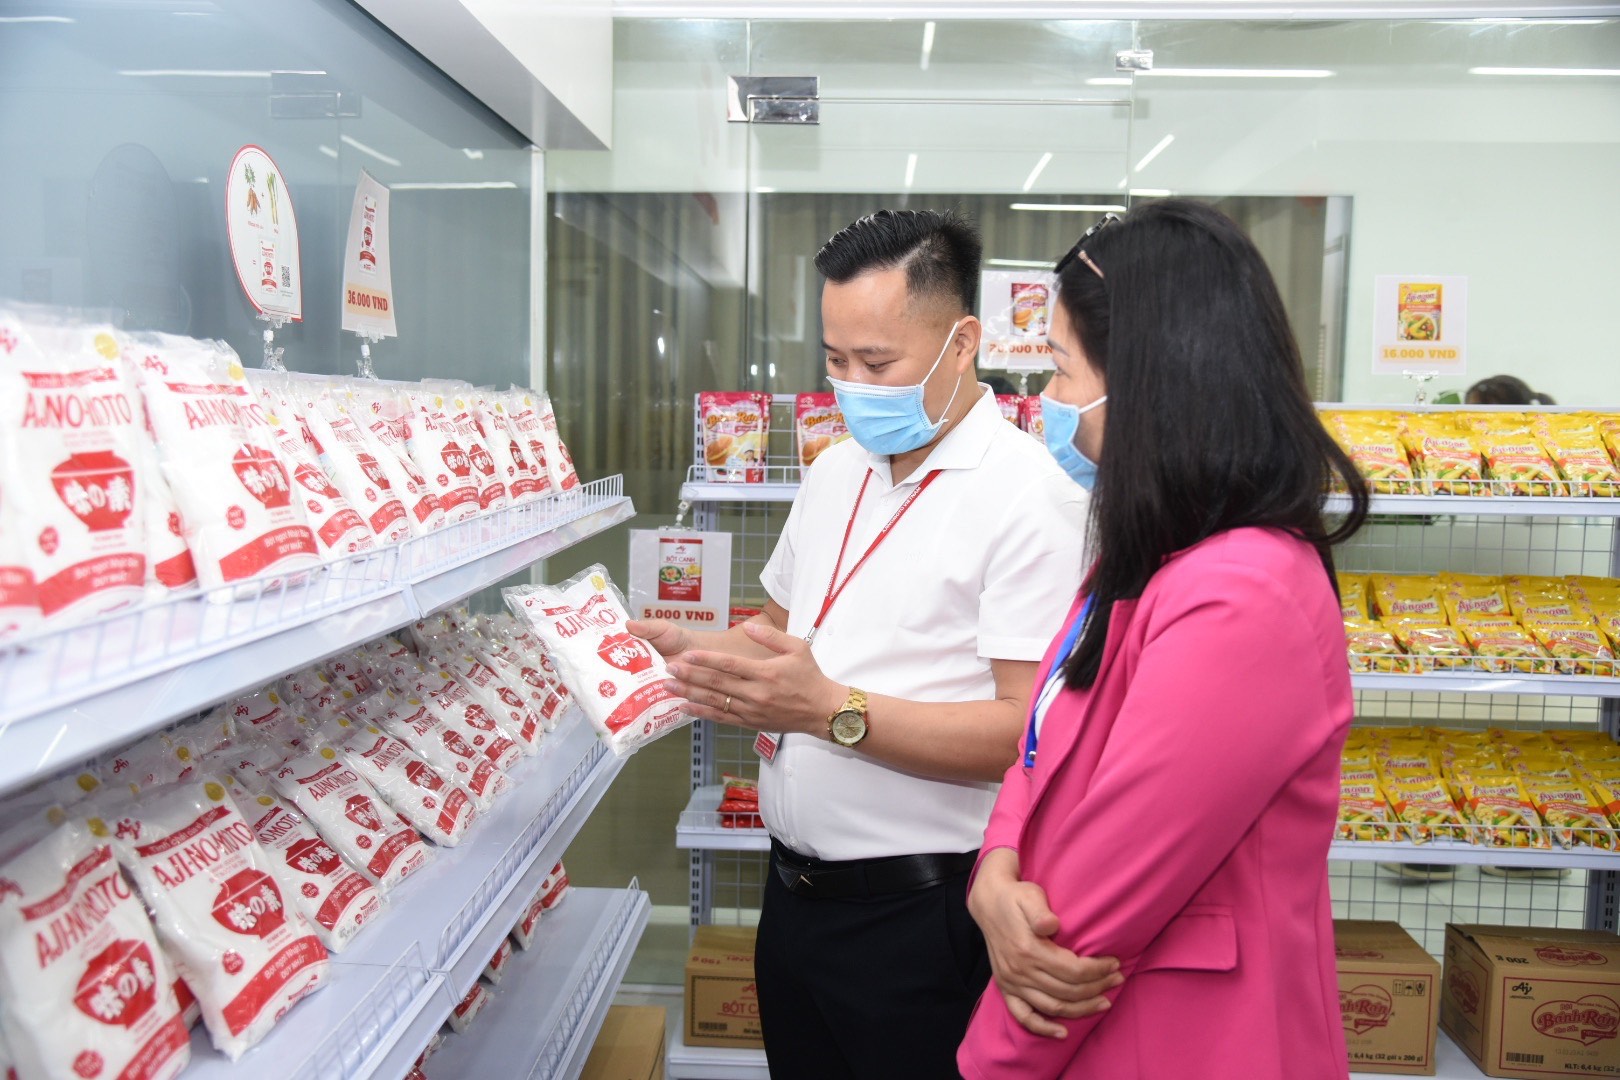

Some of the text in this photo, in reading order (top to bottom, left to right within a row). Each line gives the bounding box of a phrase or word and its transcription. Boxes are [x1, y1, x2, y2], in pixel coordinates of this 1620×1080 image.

[347, 290, 388, 311] 36.000 VND
[1036, 345, 1053, 354] VN
[1383, 349, 1457, 359] 16.000 VND
[644, 608, 715, 621] 5.000 VND
[722, 1000, 747, 1015] BỘT
